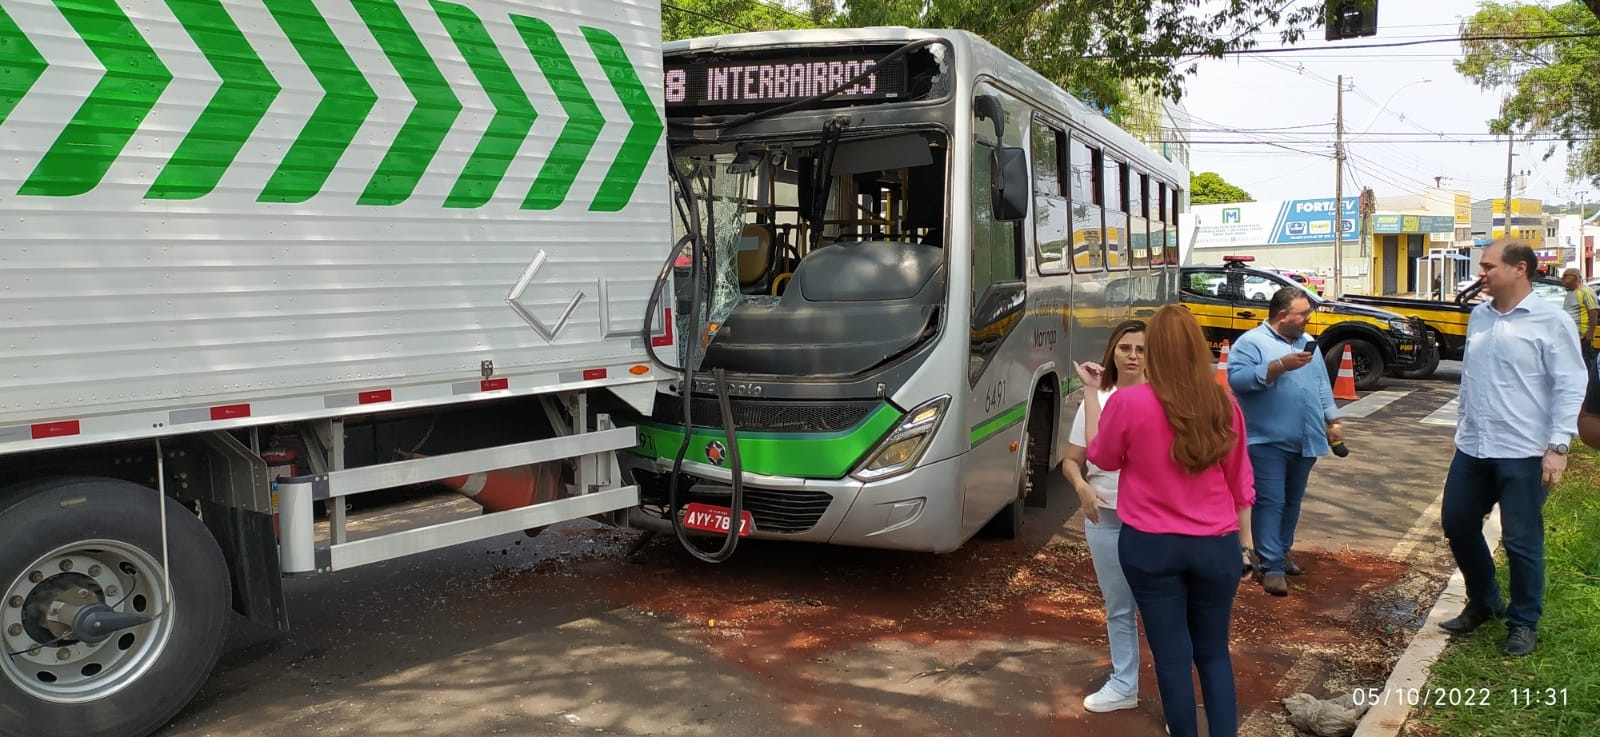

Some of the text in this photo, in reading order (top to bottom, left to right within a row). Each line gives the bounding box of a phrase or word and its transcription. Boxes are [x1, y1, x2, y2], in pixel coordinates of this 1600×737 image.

[707, 59, 877, 101] INTERBAIRROS
[985, 380, 1006, 413] 6491
[687, 511, 746, 533] AYY-787
